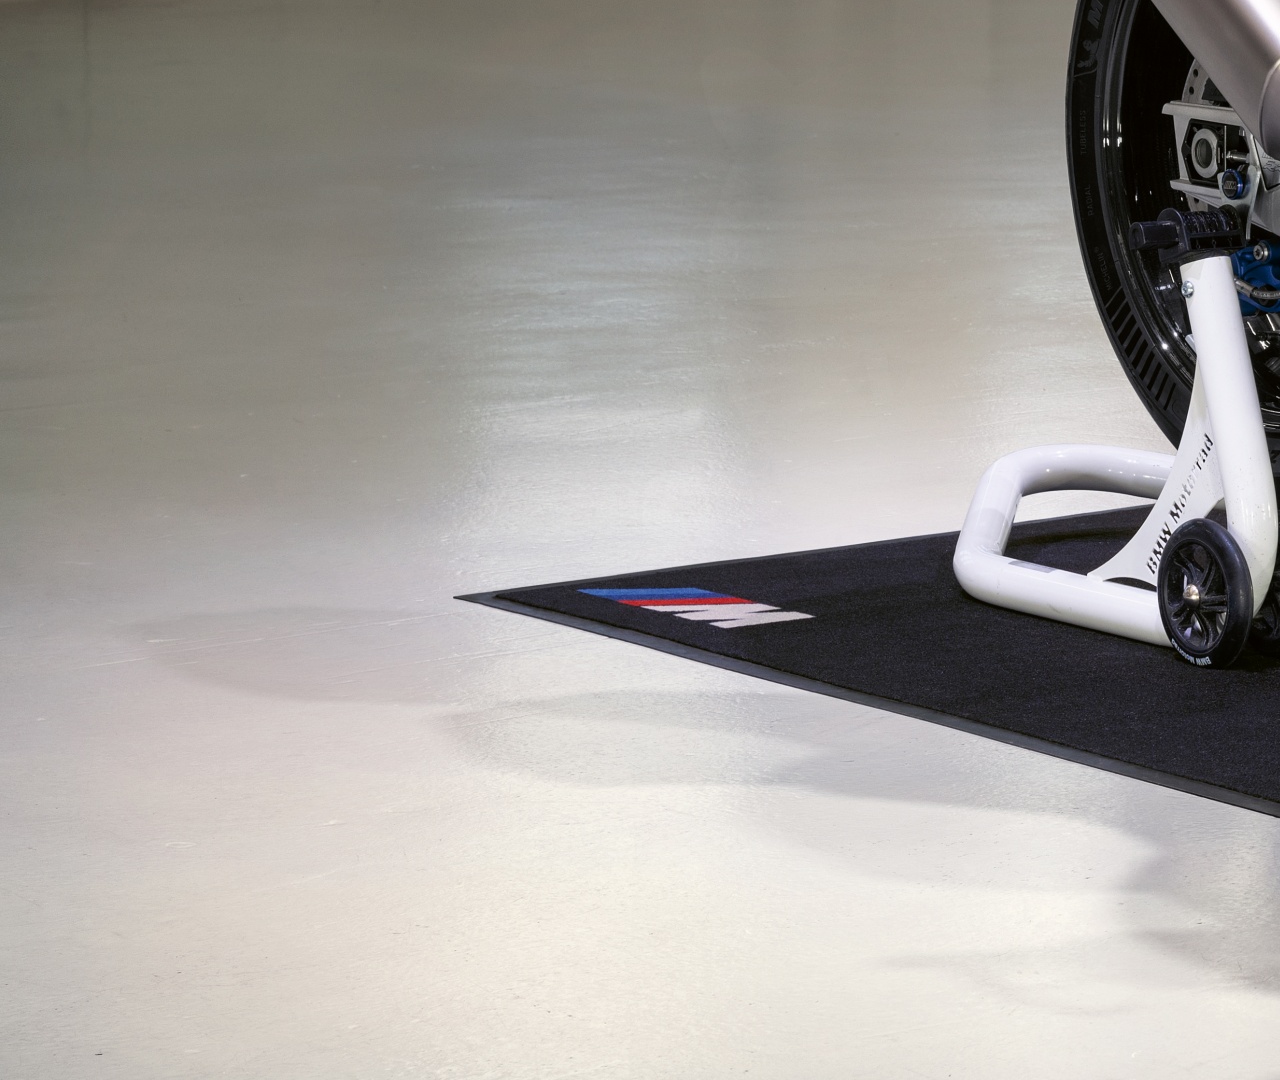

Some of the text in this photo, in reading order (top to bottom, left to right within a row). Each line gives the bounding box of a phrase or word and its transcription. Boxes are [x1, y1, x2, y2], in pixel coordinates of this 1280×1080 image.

[1079, 110, 1087, 156] TUBELESS
[1085, 184, 1095, 217] RADIAL
[1147, 522, 1172, 575] BMW
